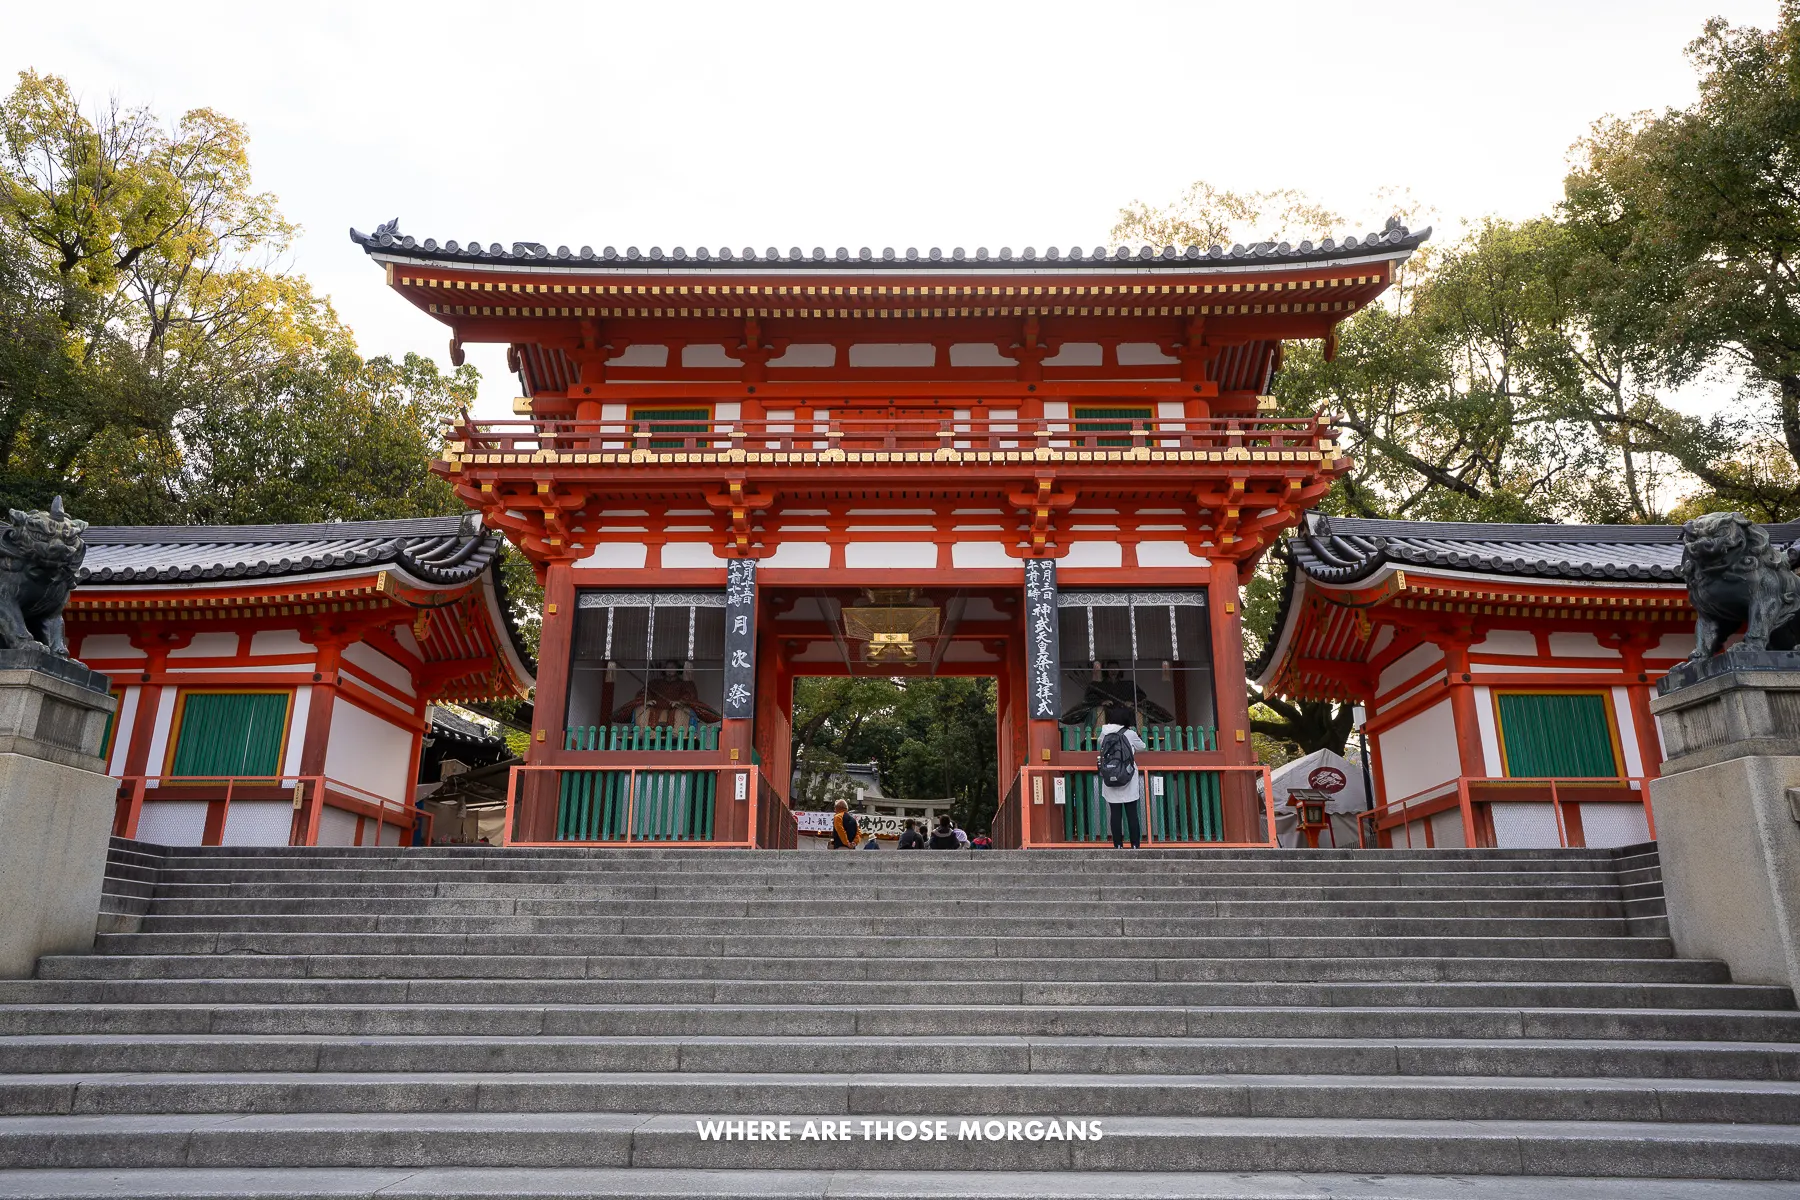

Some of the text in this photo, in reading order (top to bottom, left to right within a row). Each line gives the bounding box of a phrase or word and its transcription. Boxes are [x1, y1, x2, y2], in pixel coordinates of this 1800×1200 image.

[727, 560, 742, 608] 午前十時
[740, 559, 755, 604] 四月十五日
[1026, 559, 1041, 601] 午前十時
[1040, 560, 1054, 600] 四月三日
[726, 615, 751, 709] 月次祭
